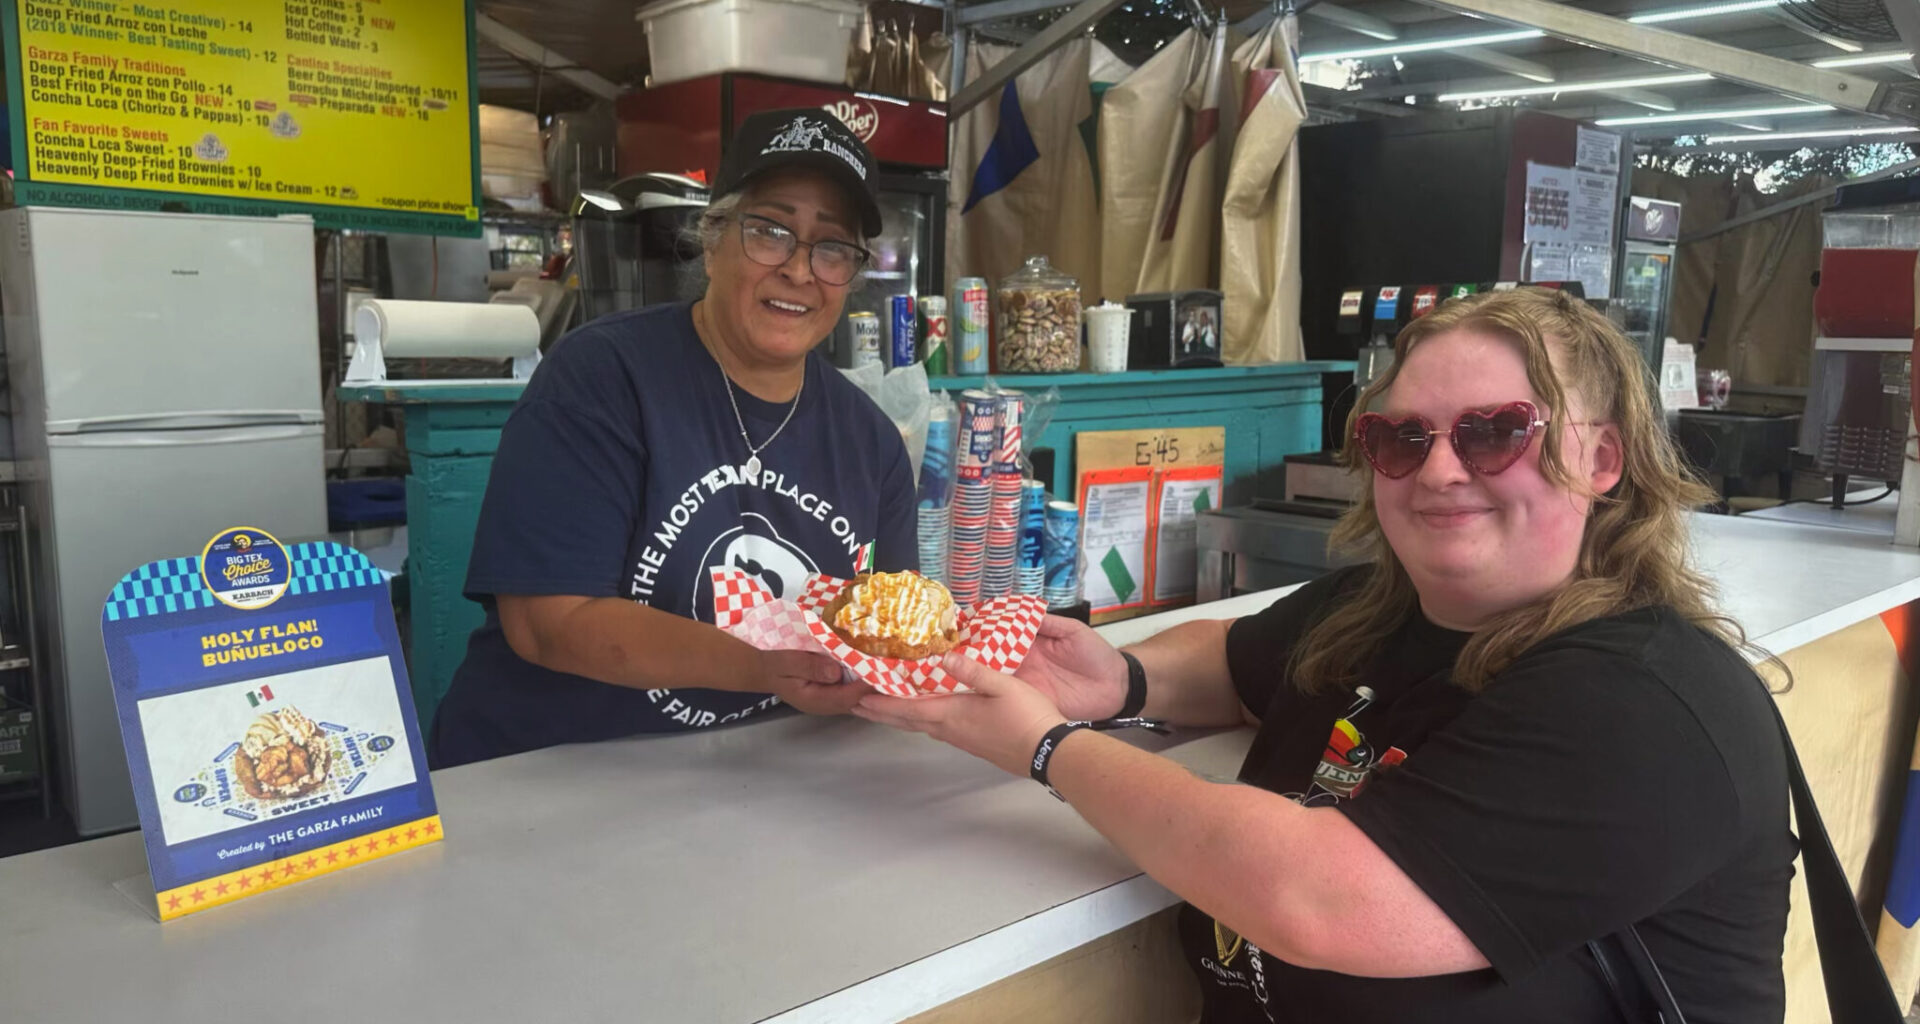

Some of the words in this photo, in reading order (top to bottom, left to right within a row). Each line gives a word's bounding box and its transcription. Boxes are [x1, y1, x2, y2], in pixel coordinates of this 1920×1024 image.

[26, 4, 61, 21] Deep
[66, 8, 101, 25] Fried
[105, 14, 140, 30] Arroz
[143, 22, 166, 34] con
[170, 22, 208, 39] Leche
[134, 5, 165, 23] Most
[169, 10, 227, 30] Creative)
[238, 21, 253, 33] 14
[285, 2, 308, 16] Iced
[312, 7, 347, 23] Coffee
[371, 17, 396, 31] NEW
[355, 2, 363, 13] 5
[26, 17, 66, 34] (2018
[128, 31, 157, 46] Best
[162, 36, 205, 55] Tasting
[209, 41, 251, 60] Sweet)
[263, 50, 278, 63] 12
[285, 15, 305, 28] Hot
[308, 19, 343, 34] Coffee
[353, 26, 361, 38] 2
[286, 28, 326, 45] Bottled
[329, 35, 361, 51] Water
[371, 42, 378, 53] 3
[28, 46, 68, 63] Garza
[73, 51, 119, 71] Family
[123, 57, 187, 77] Traditions
[287, 54, 330, 71] Cantina
[333, 60, 393, 80] Specialties
[29, 60, 65, 77] Deep
[70, 65, 104, 81] Fried
[109, 70, 143, 86] Arroz
[147, 77, 170, 89] con
[173, 75, 206, 93] Pollo
[217, 84, 233, 96] 14
[287, 67, 314, 81] Beer
[317, 71, 372, 89] Domestic/
[375, 79, 421, 98] Imported
[288, 79, 339, 97] Borracho
[342, 87, 397, 105] Michelada
[31, 75, 61, 90] Best
[66, 78, 96, 94] Frito
[101, 82, 122, 98] Pie
[127, 87, 142, 99] on
[146, 86, 166, 102] the
[170, 90, 187, 105] Go
[195, 93, 224, 108] NEW
[237, 100, 251, 111] 10
[31, 89, 82, 107] Concha
[86, 94, 118, 110] Loca
[122, 98, 176, 116] (Chorizo
[180, 106, 189, 118] &
[194, 107, 243, 126] Pappas)
[255, 115, 270, 127] 10
[320, 97, 376, 116] Preparada
[381, 105, 407, 119] NEW
[33, 117, 59, 132] Fan
[64, 120, 118, 138] Favorite
[122, 126, 169, 143] Sweets
[34, 132, 85, 149] Concha
[89, 136, 121, 151] Loca
[125, 140, 164, 156] Sweet
[177, 145, 193, 158] 10
[35, 147, 98, 166] Heavenly
[103, 152, 175, 172] Deep-Fried
[179, 158, 235, 176] Brownies
[247, 165, 262, 178] 10
[36, 161, 100, 180] Heavenly
[104, 166, 137, 183] Deep
[141, 168, 174, 183] Fried
[178, 172, 234, 189] Brownies
[238, 178, 252, 191] w/
[255, 179, 272, 192] Ice
[275, 181, 313, 195] Cream
[324, 186, 337, 198] 12
[26, 190, 46, 202] NO
[49, 191, 121, 206] ALCOHOLIC
[382, 197, 417, 209] coupon
[418, 199, 441, 211] price
[856, 323, 878, 337] Mod
[906, 319, 916, 365] ULTRA
[631, 546, 667, 595] THE
[654, 483, 705, 549] MOST
[762, 470, 832, 521] PLACE
[830, 516, 861, 556] ON
[223, 558, 273, 581] Choice
[226, 556, 243, 565] BIG
[244, 553, 263, 563] TEX
[231, 574, 271, 588] AWARDS
[232, 589, 274, 600] KARBACH
[201, 628, 255, 650] HOLY
[260, 619, 318, 641] FLAN!
[202, 635, 324, 667] BUÑUELOCO
[662, 698, 717, 727] FAIR
[343, 736, 364, 768] DELISH
[1034, 738, 1052, 771] Jeep
[214, 767, 232, 803] SIPPER
[271, 794, 331, 816] SWEET
[217, 842, 253, 860] Created
[254, 840, 266, 852] by
[268, 830, 294, 846] THE
[297, 819, 339, 838] GARZA
[340, 806, 384, 826] FAMILY
[1201, 957, 1246, 981] GUINNE
